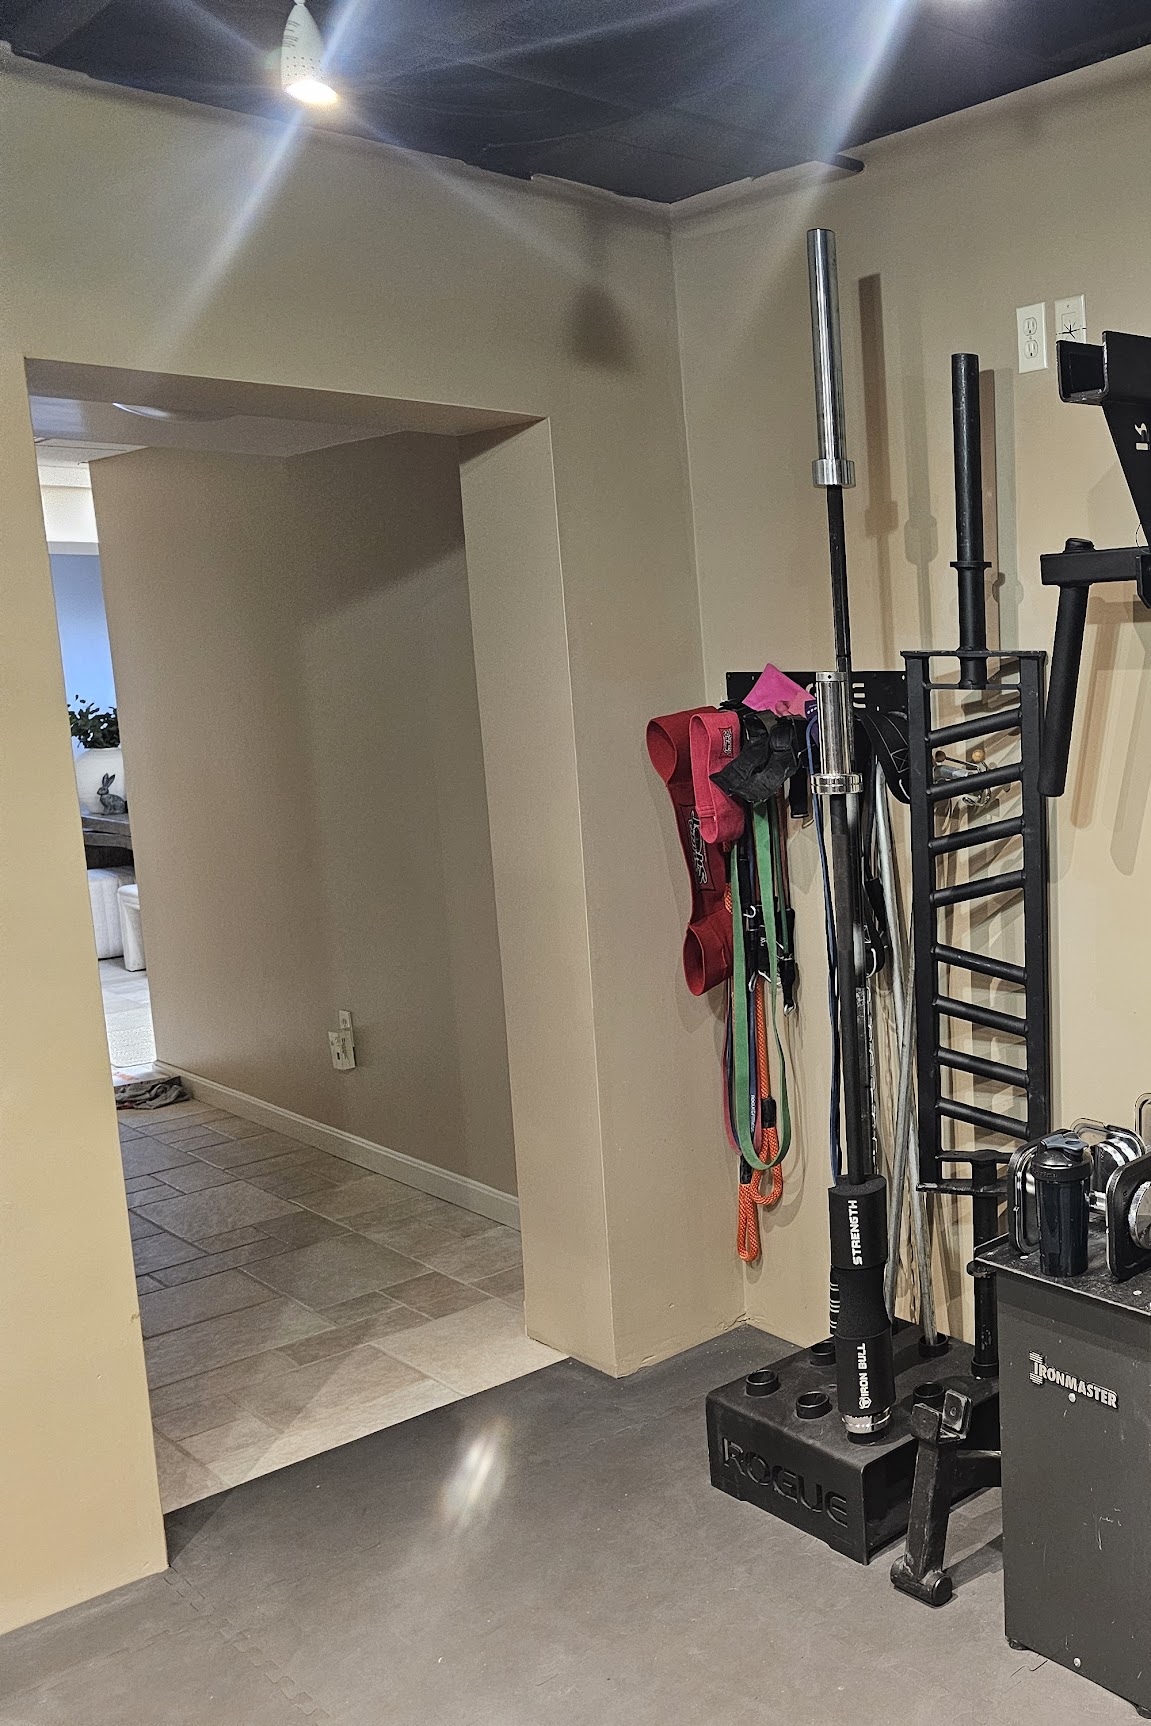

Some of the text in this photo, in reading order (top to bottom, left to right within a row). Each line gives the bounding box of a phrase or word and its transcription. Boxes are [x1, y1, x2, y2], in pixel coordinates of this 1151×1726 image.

[848, 1199, 863, 1266] STRENGTH
[857, 1342, 870, 1398] IRON BULL
[1029, 1351, 1118, 1410] IRONMASTER
[722, 1438, 848, 1529] ROGUE
